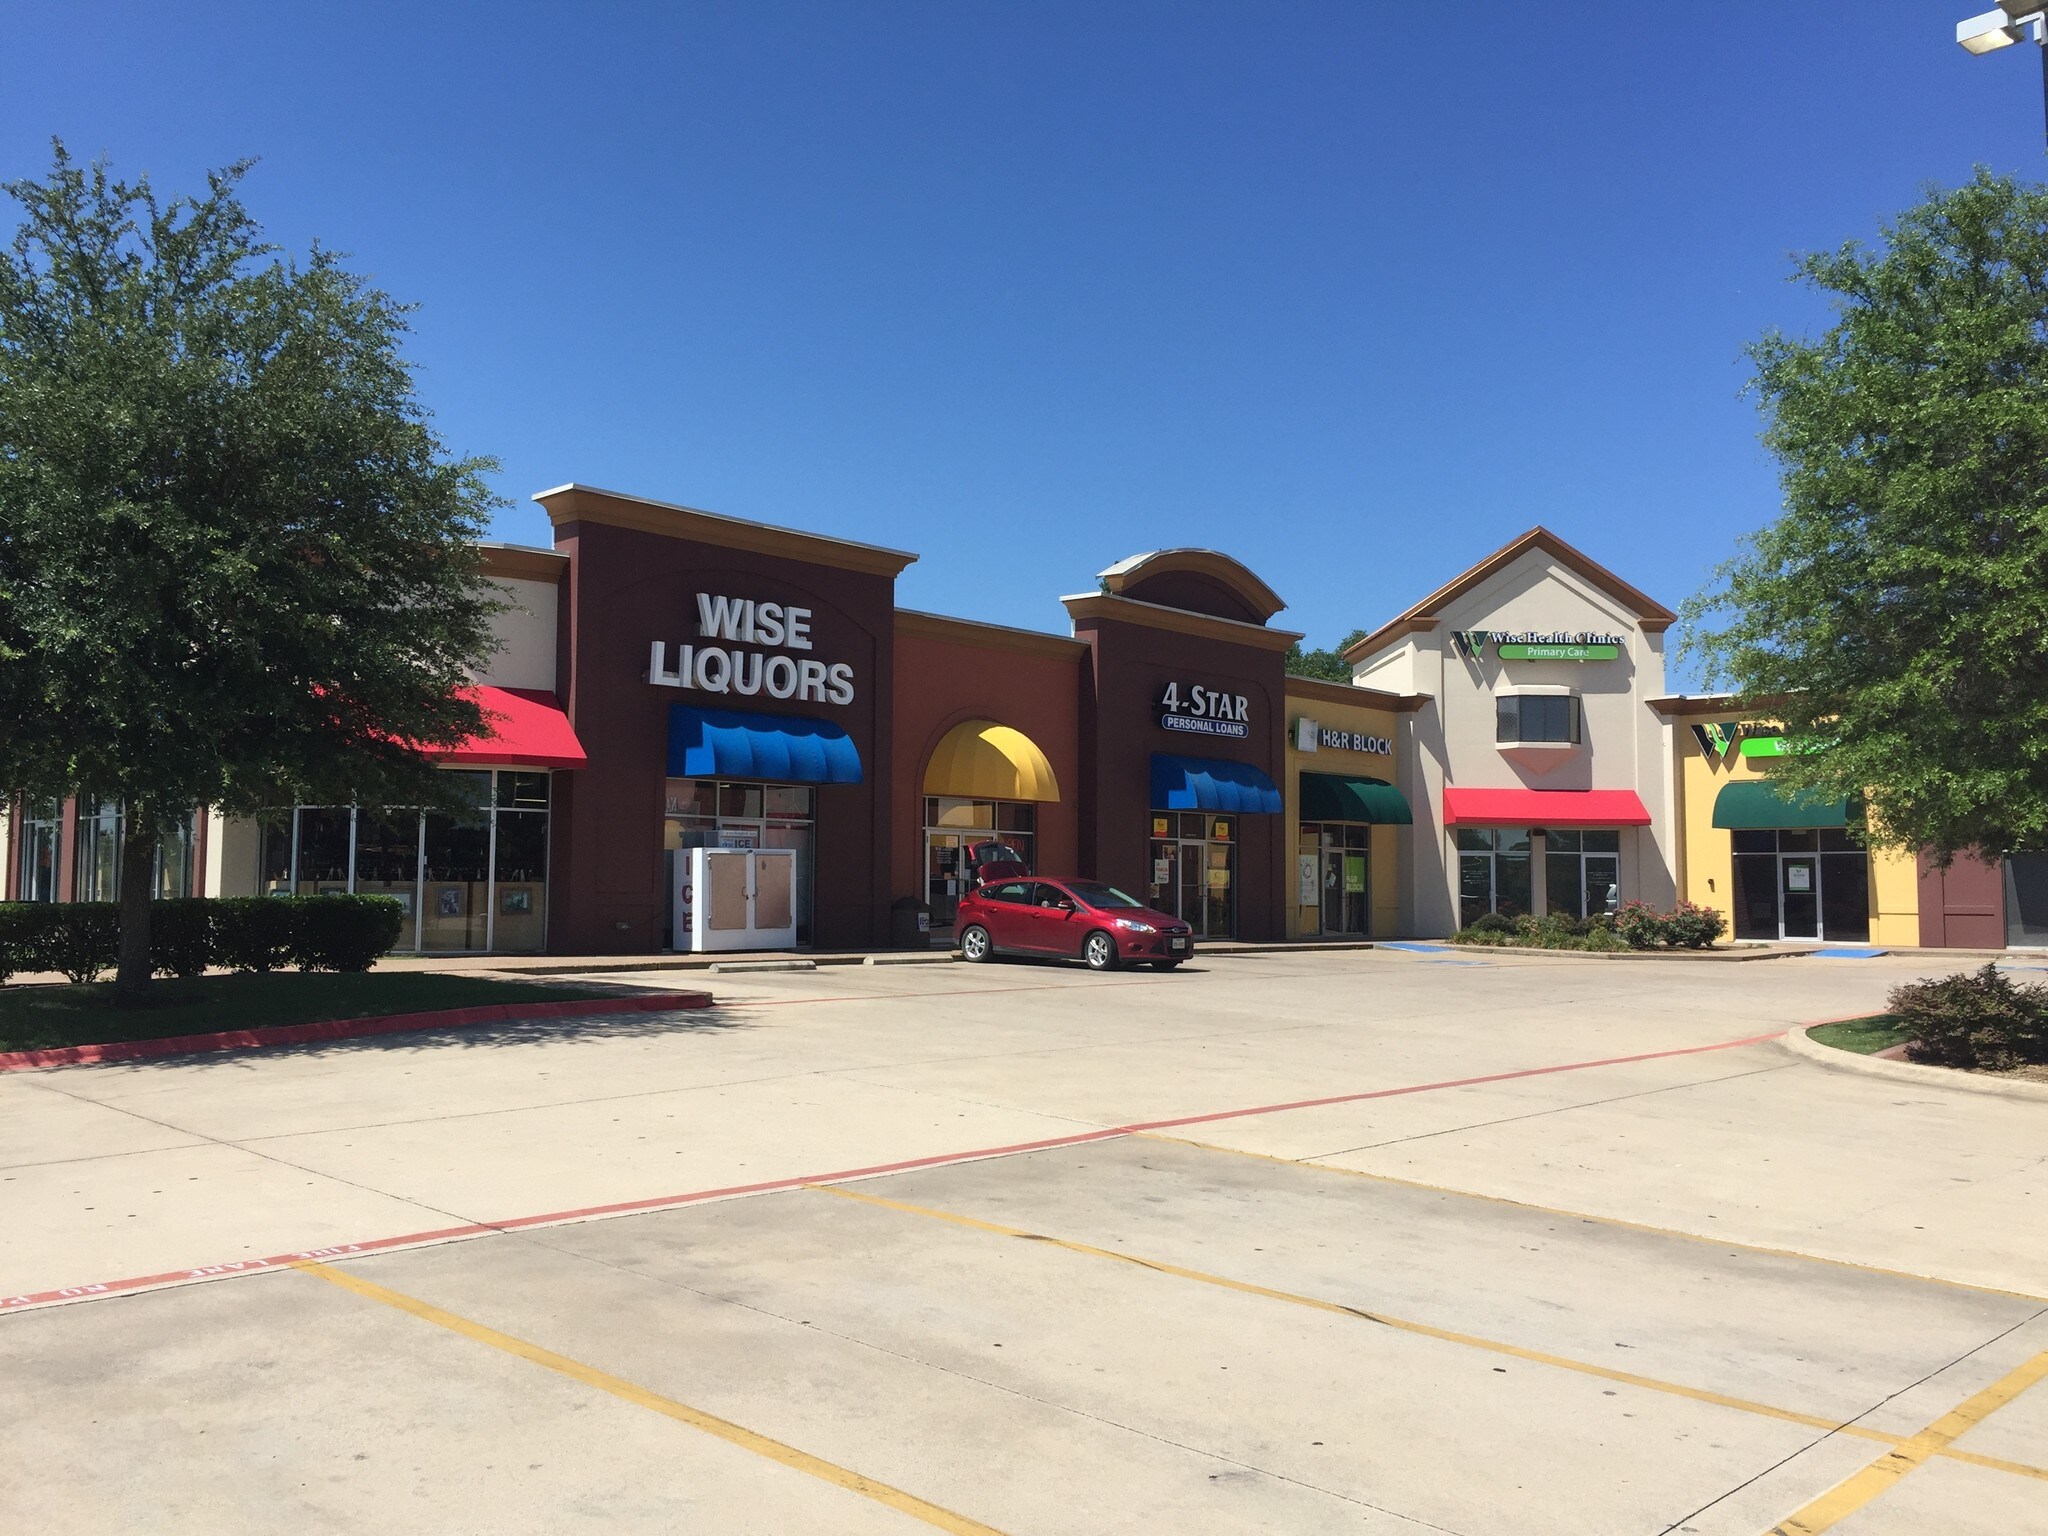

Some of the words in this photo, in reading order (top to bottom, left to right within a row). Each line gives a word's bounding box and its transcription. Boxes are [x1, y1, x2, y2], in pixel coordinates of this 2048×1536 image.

[697, 593, 813, 650] WISE
[1491, 631, 1524, 644] Wise
[1526, 631, 1573, 644] Health
[1575, 632, 1625, 644] Clinics
[1527, 646, 1565, 658] Primary
[1567, 648, 1590, 657] Care
[650, 641, 855, 705] LIQUORS
[1162, 682, 1249, 721] 4-STAR
[1167, 716, 1214, 732] PERSONAL
[1216, 722, 1244, 735] LOANS
[1322, 729, 1349, 749] H&R
[1353, 733, 1393, 755] BLOCK
[735, 839, 751, 848] ICE
[682, 856, 693, 932] ICE
[292, 1245, 361, 1260] FIRE
[189, 1259, 269, 1278] LANE
